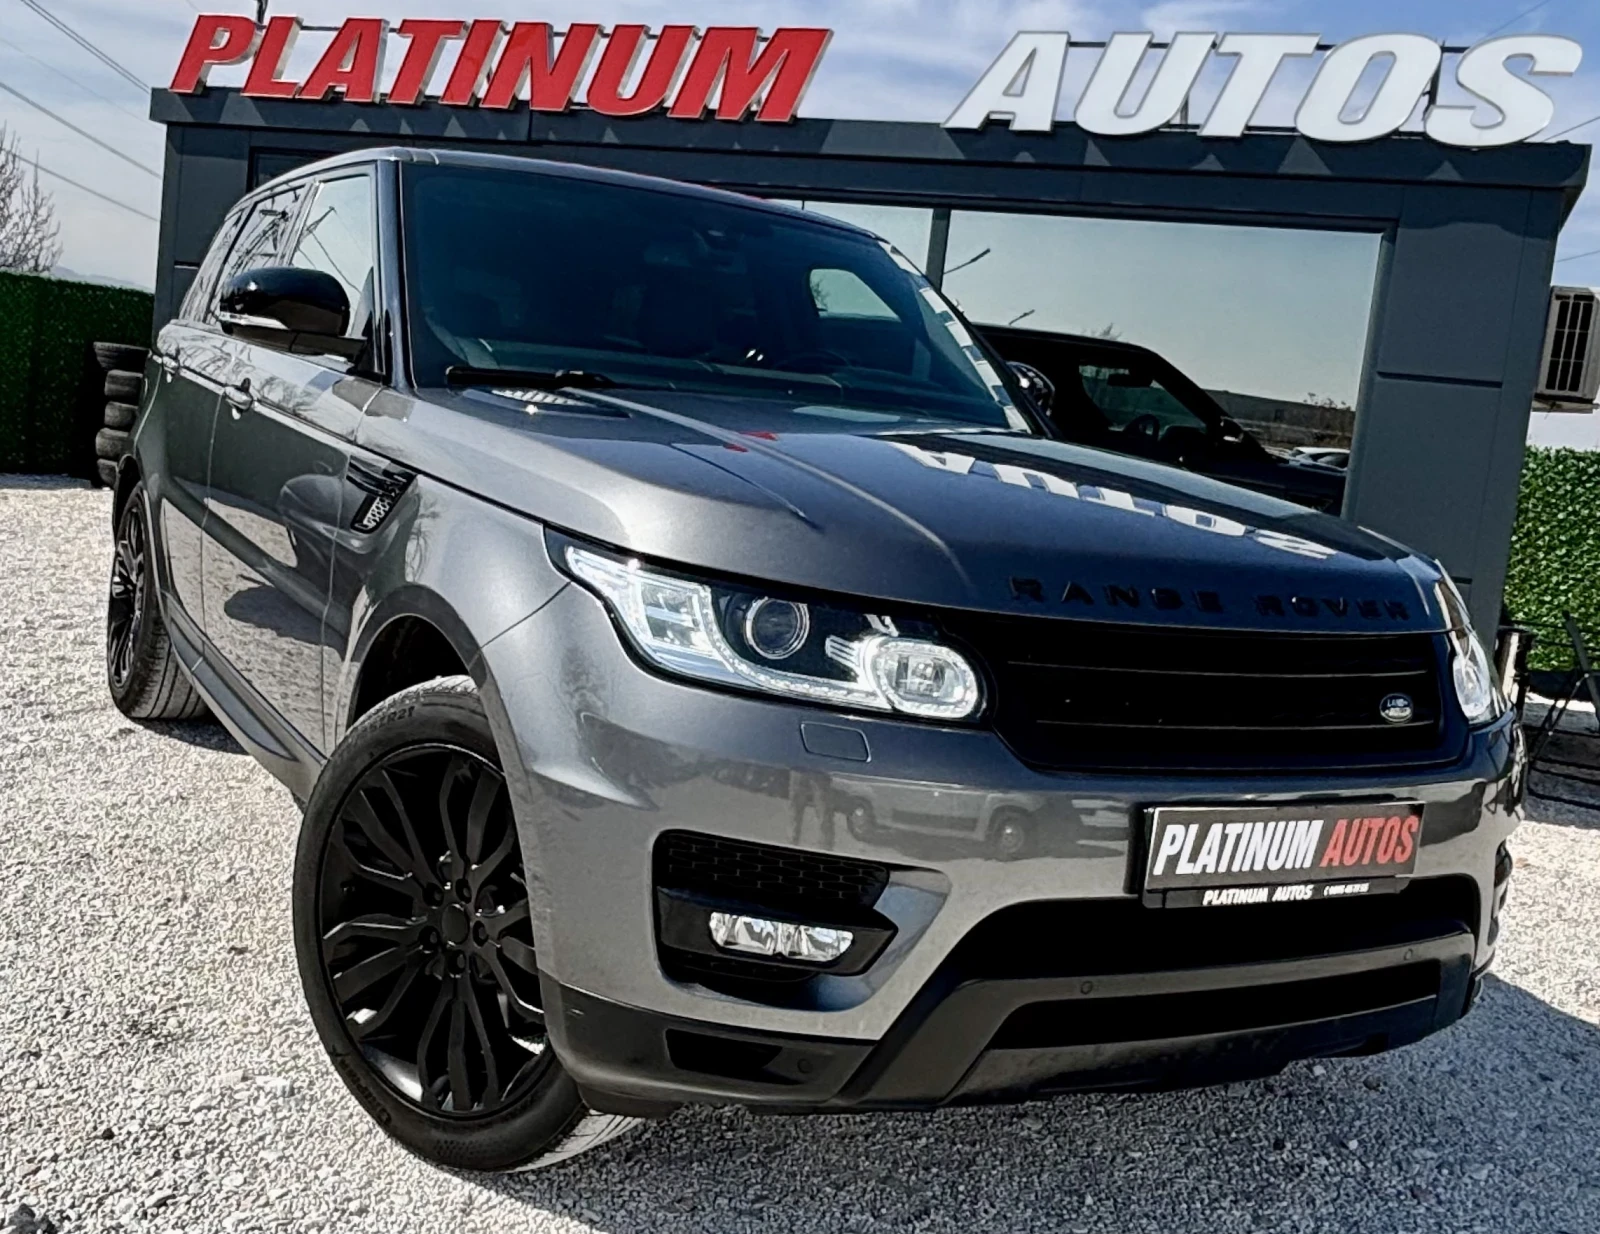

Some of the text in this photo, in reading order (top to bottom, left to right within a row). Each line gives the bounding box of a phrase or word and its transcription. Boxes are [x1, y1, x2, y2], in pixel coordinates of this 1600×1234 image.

[168, 14, 1583, 148] PLATINUM AUTOS
[1009, 575, 1411, 621] RANGE ROVER
[1153, 815, 1419, 875] PLATINUM AUTOS
[1202, 887, 1269, 906] PLATINUM
[1272, 884, 1315, 902] AUTOS
